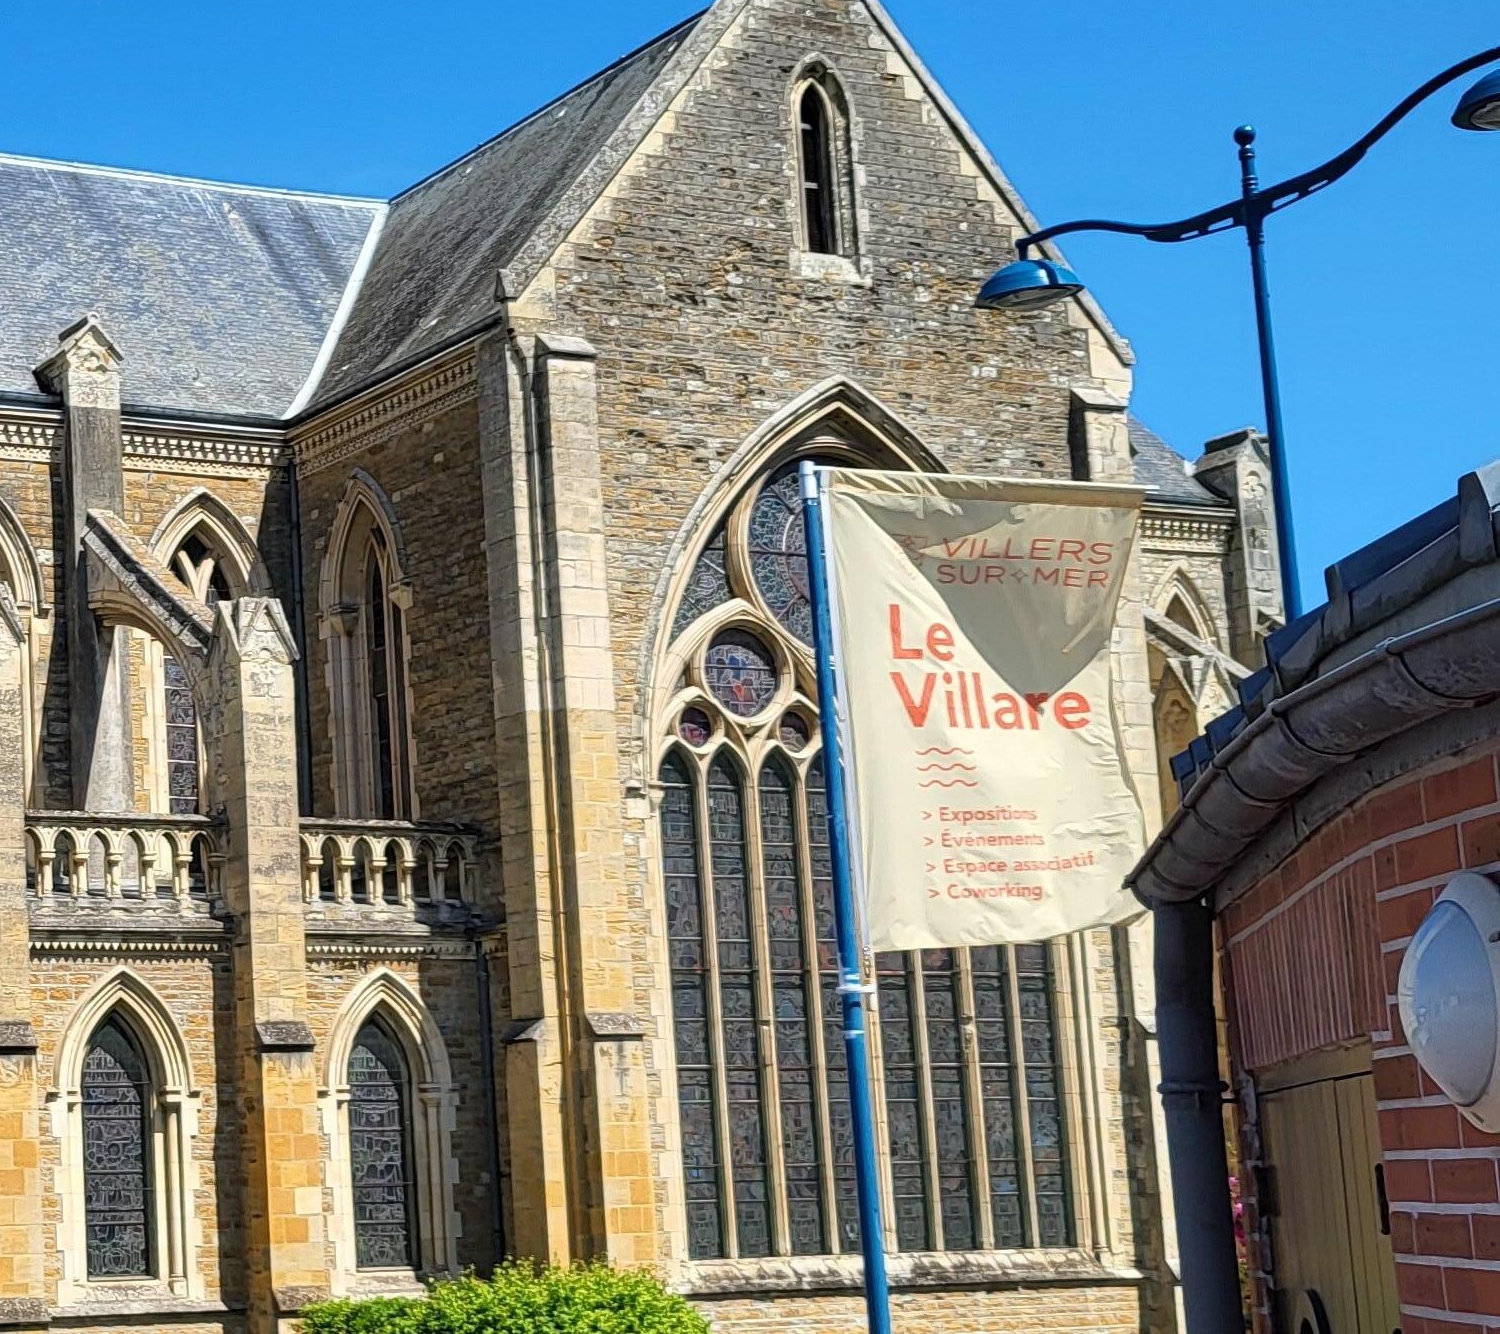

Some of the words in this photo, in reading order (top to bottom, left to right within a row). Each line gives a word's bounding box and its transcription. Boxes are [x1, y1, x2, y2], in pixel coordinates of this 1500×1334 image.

[942, 537, 1114, 565] VILLERS
[936, 564, 1005, 585] SUR
[1033, 567, 1108, 588] MER
[889, 604, 956, 661] Le
[889, 671, 1091, 730] Villare
[939, 805, 1037, 825] Expositions
[941, 828, 1045, 848] Événements
[943, 858, 1008, 877] Espace
[1013, 851, 1093, 872] associatif
[947, 882, 1044, 901] Coworking
